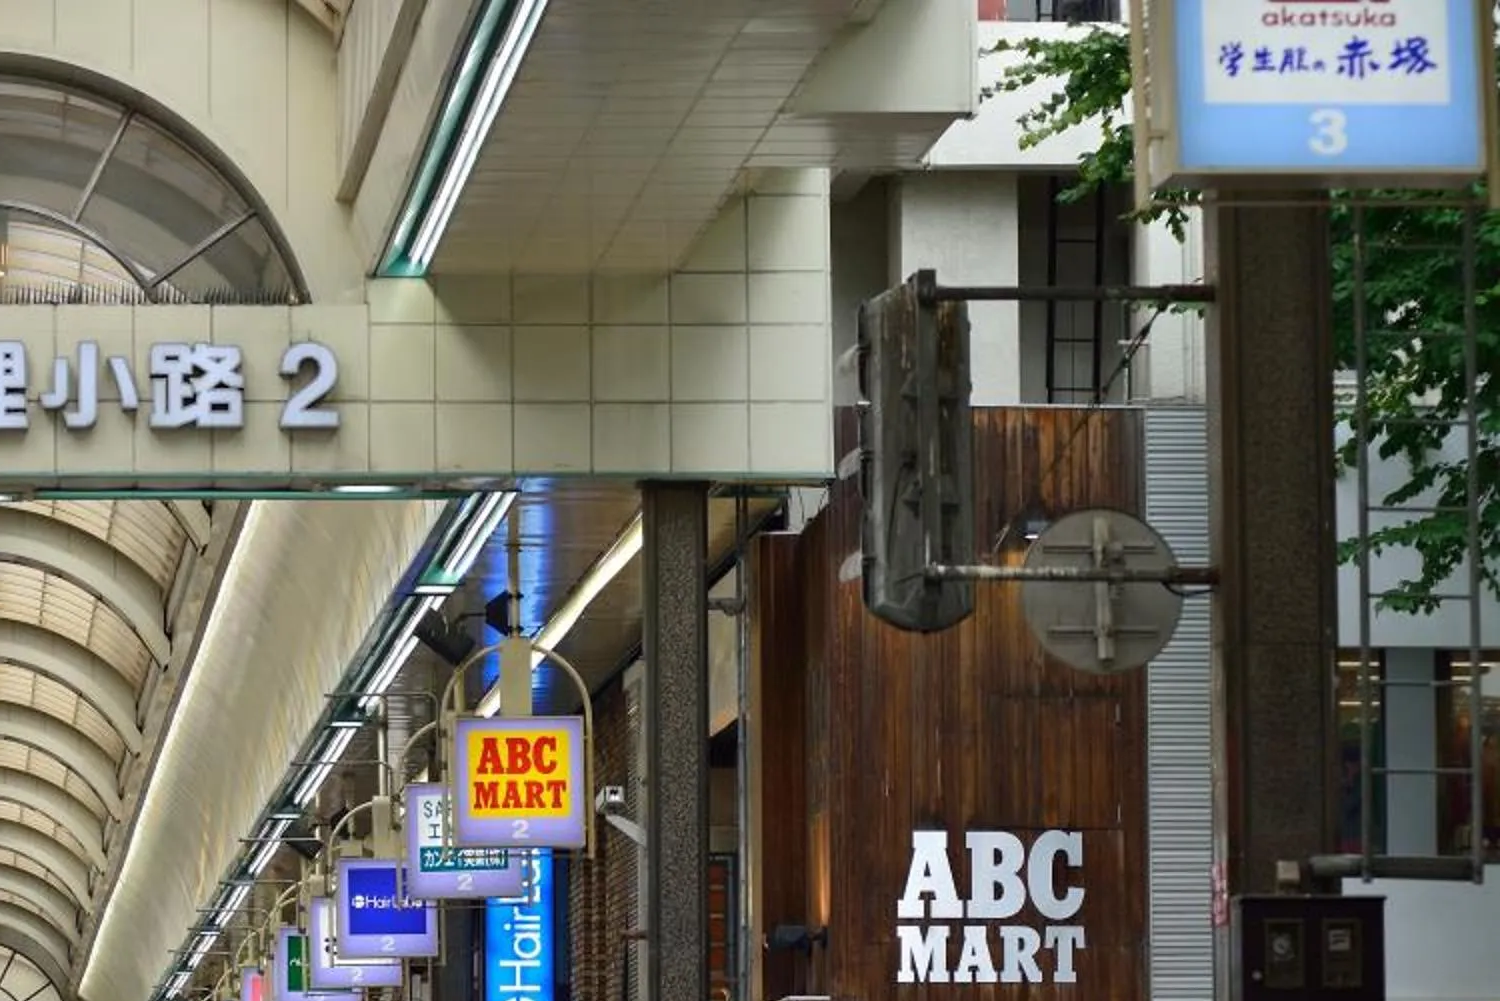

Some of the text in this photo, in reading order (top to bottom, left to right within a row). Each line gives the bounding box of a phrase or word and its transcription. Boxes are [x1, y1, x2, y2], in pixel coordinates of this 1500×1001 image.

[1262, 7, 1396, 28] akatsuka
[1218, 34, 1438, 80] 学生服の赤塚
[1308, 108, 1348, 157] 3
[476, 735, 558, 775] ABC
[473, 780, 567, 810] MART
[511, 819, 530, 839] 2
[456, 873, 474, 891] 2
[897, 829, 1086, 921] ABC
[380, 936, 396, 951] 2
[896, 925, 1086, 984] MART
